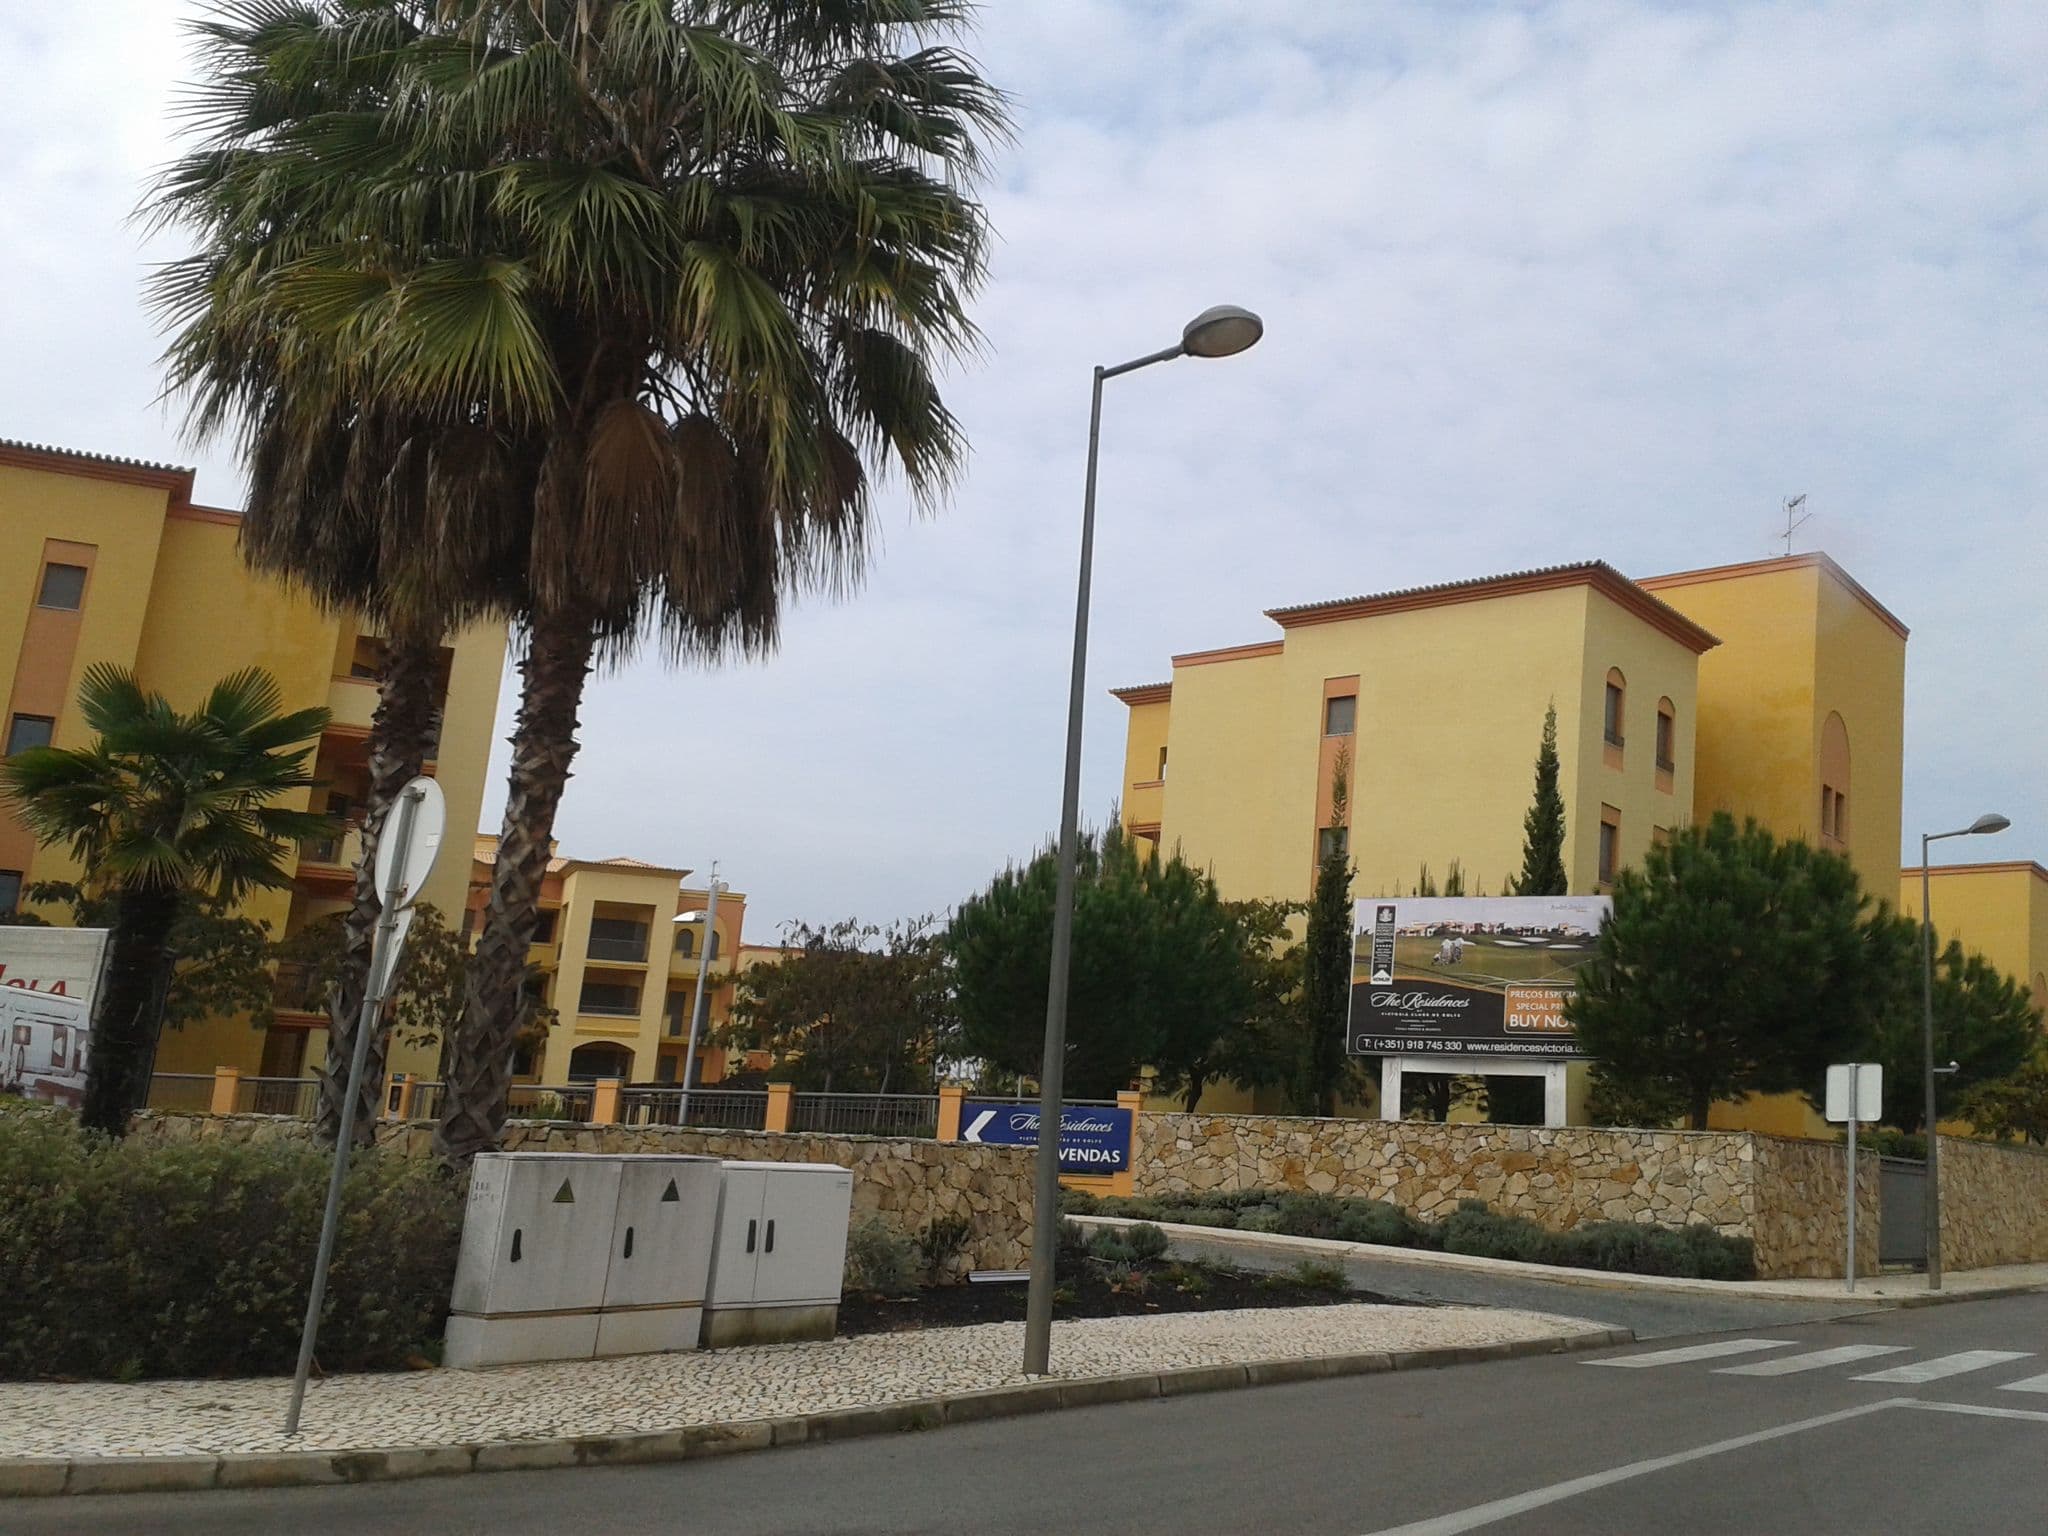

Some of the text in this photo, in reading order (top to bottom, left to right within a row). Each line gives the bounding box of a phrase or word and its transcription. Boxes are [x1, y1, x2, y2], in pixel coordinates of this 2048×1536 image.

[1370, 992, 1470, 1010] The Residences
[1510, 990, 1577, 999] PREÇOS ESPECIA
[1516, 1002, 1549, 1010] SPECIAL
[1509, 1014, 1541, 1027] BUY
[1373, 1039, 1404, 1050] (+351)
[1406, 1040, 1424, 1050] 918
[1426, 1040, 1443, 1050] 745
[1444, 1041, 1463, 1051] 330
[1010, 1113, 1114, 1133] The esidences
[1059, 1147, 1120, 1163] VENDAS
